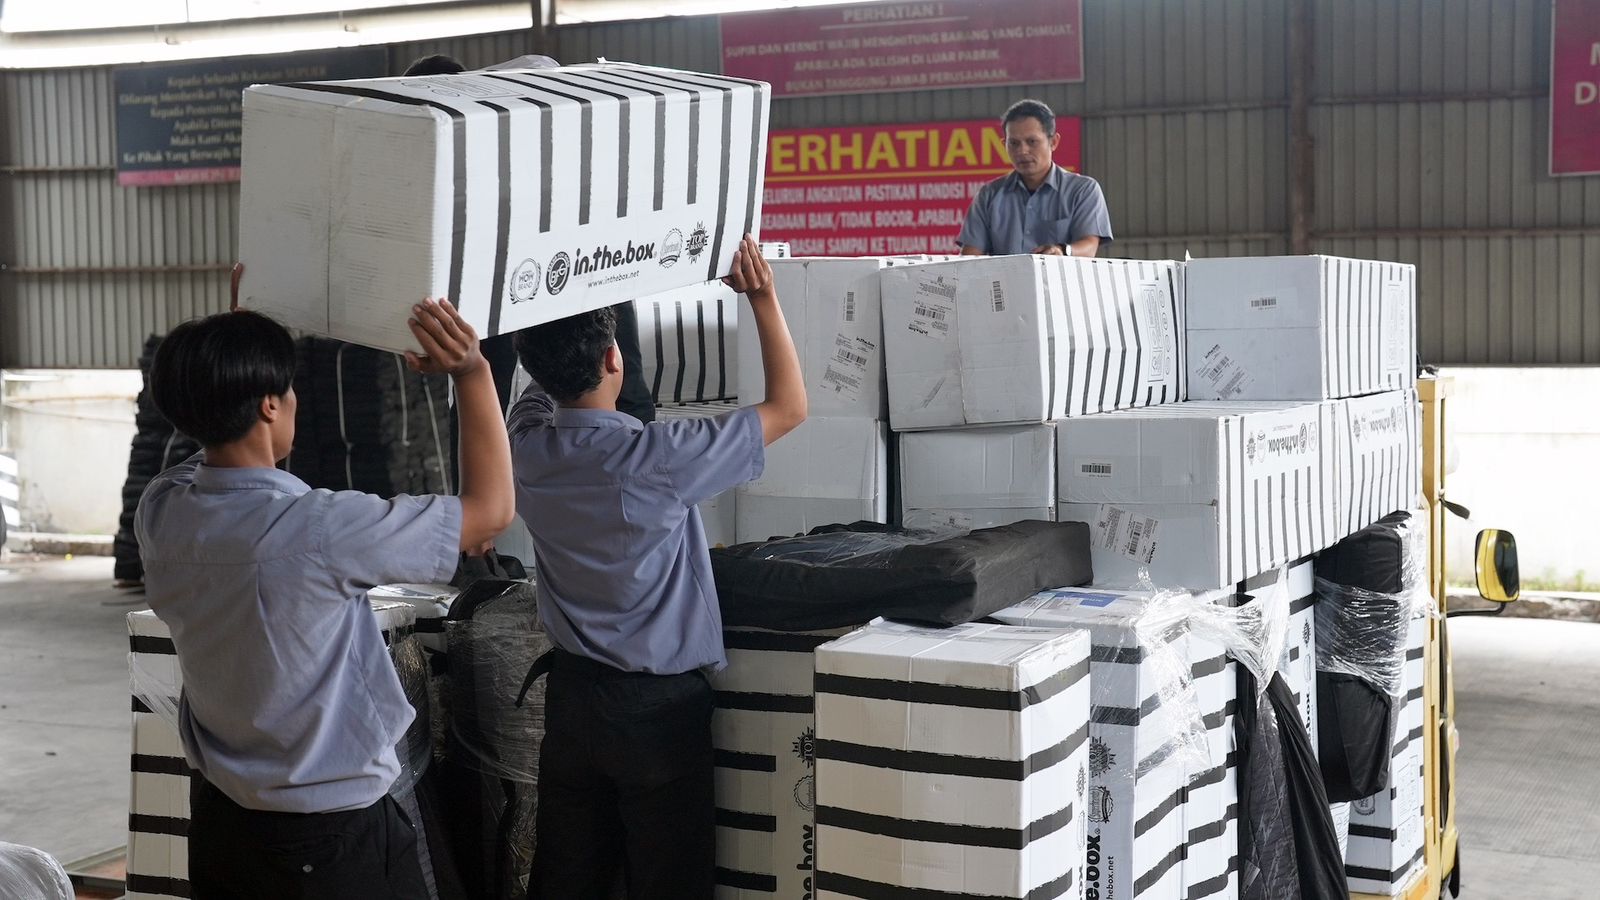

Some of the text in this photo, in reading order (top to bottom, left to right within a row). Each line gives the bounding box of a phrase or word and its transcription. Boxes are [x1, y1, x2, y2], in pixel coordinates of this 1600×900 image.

[842, 4, 934, 23] PERHATIAN
[758, 43, 782, 56] DAN
[783, 41, 824, 54] KERNET
[862, 33, 939, 50] MENGHITUNG
[940, 29, 989, 44] BARANG
[992, 26, 1024, 41] YANG
[794, 58, 840, 72] APABILA
[842, 56, 866, 70] ADA
[911, 52, 925, 66] DI
[926, 50, 956, 65] LUAR
[785, 79, 824, 93] BUKAN
[890, 73, 930, 87] JAWAB
[770, 126, 1011, 173] ERHATIAN
[763, 186, 805, 205] ELURUH
[807, 185, 861, 204] ANGKUTAN
[865, 183, 917, 202] PASTIKAN
[919, 181, 965, 200] KONDISI
[760, 213, 806, 231] KEADAAN
[918, 207, 963, 227] APABILA
[827, 236, 869, 255] SAMPAI
[870, 236, 885, 254] KE
[886, 235, 928, 254] TUJUAN
[587, 270, 640, 288] www.inthebox.net
[804, 736, 813, 758] TOP
